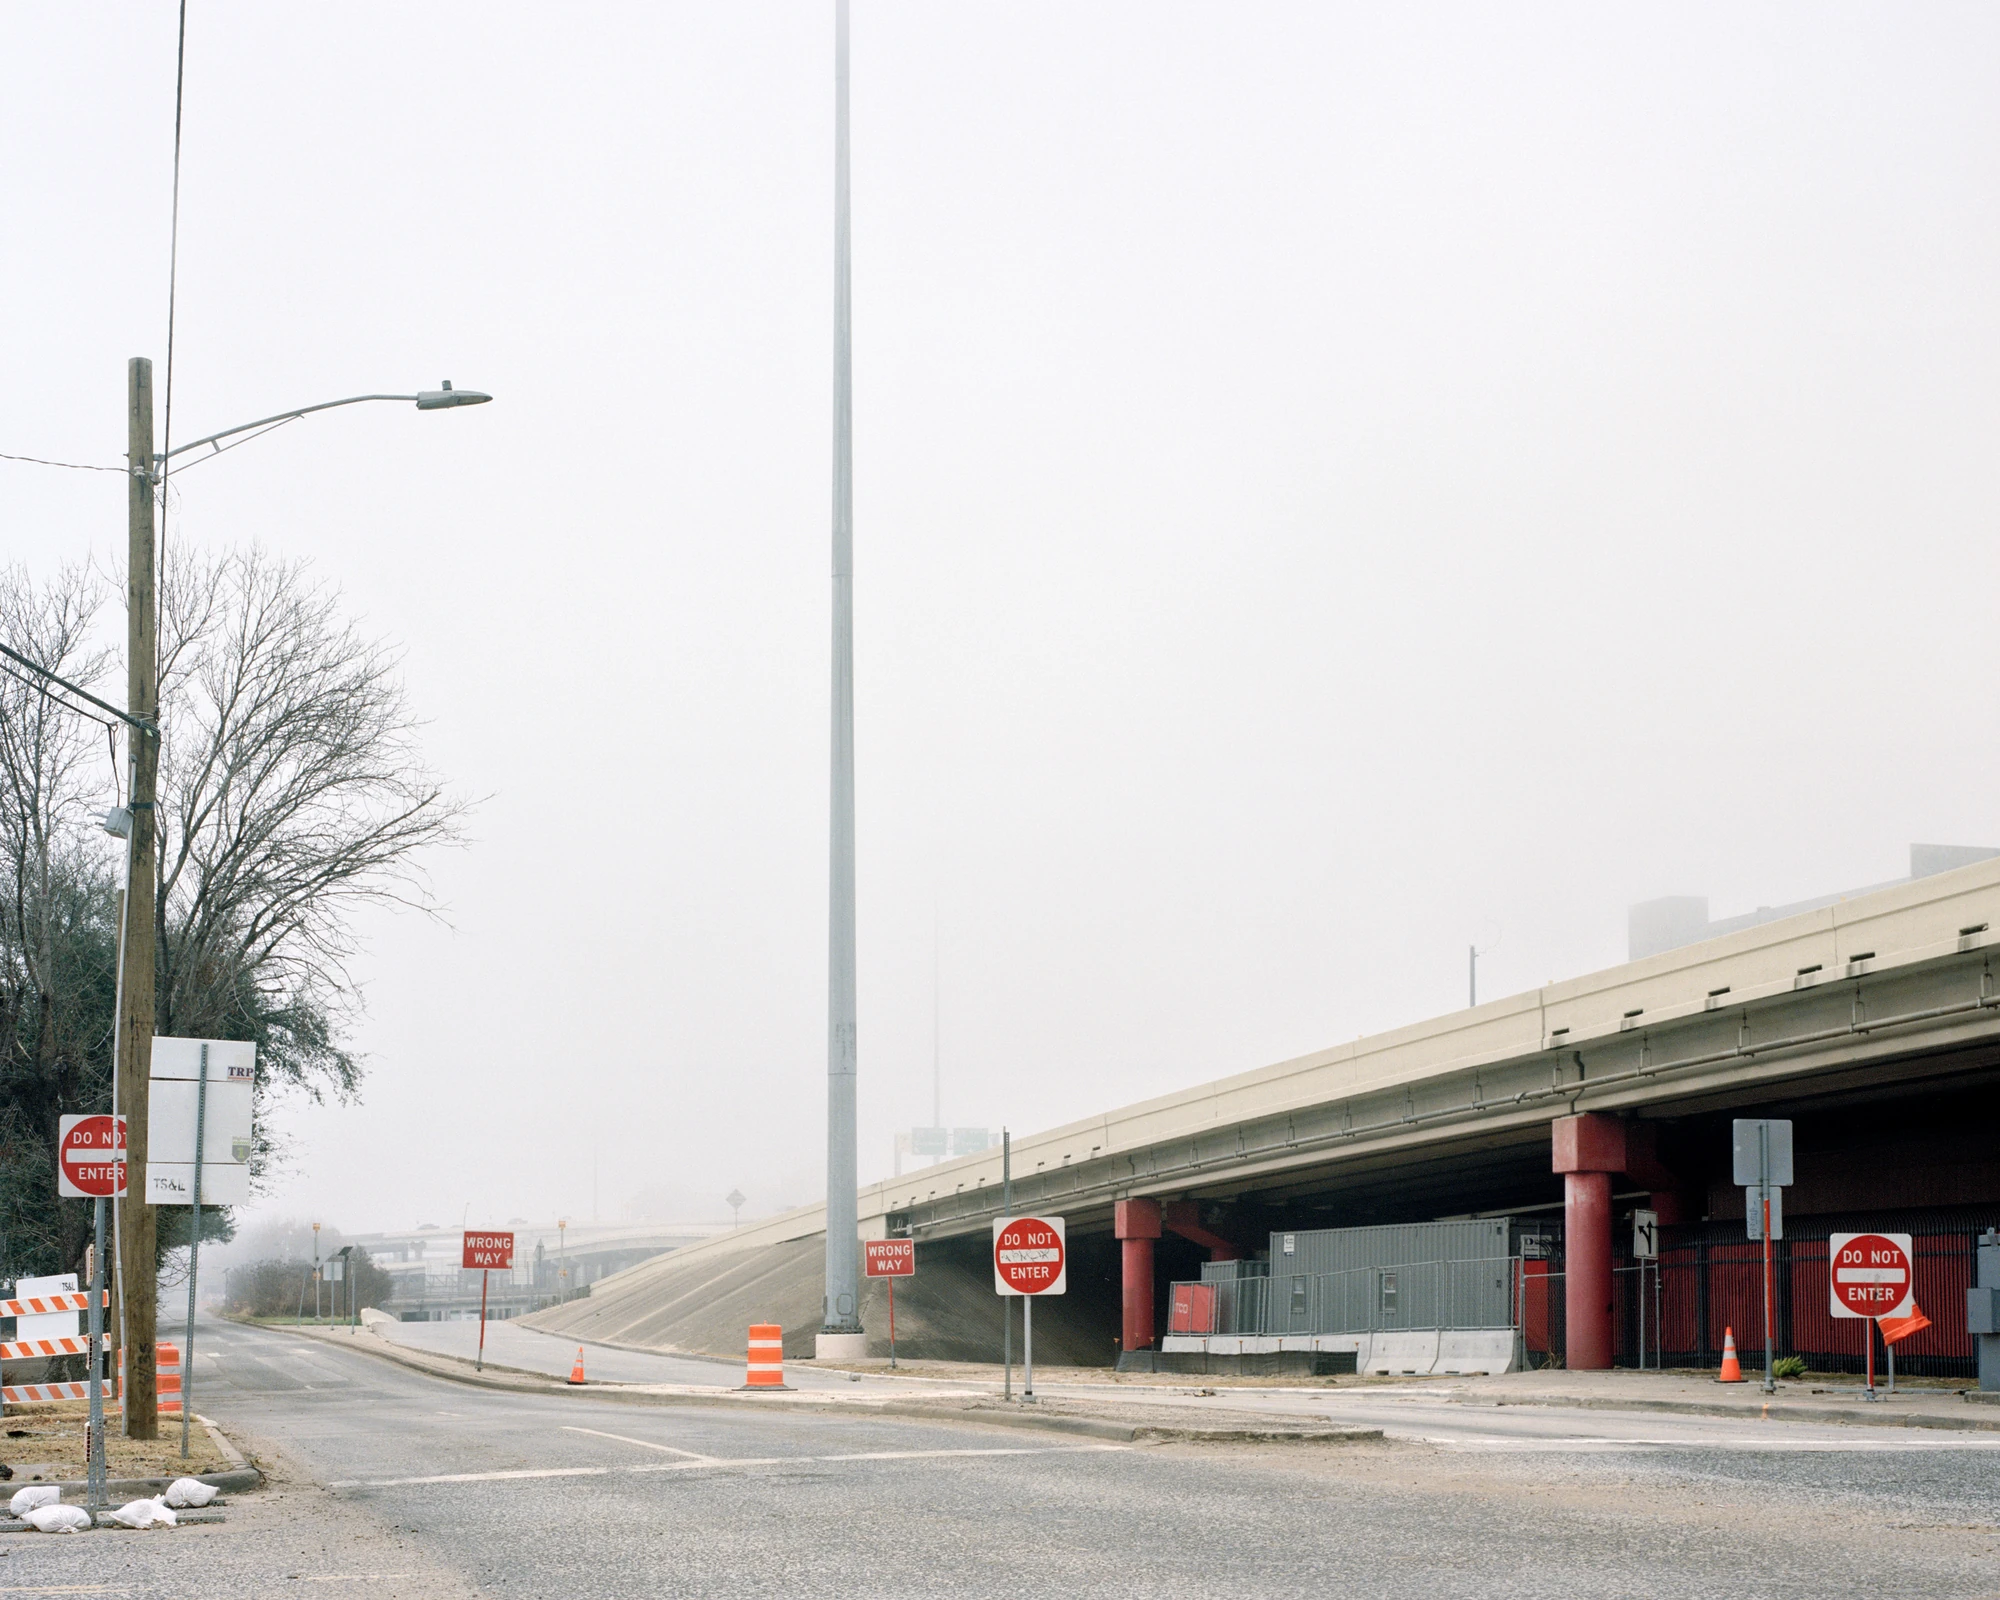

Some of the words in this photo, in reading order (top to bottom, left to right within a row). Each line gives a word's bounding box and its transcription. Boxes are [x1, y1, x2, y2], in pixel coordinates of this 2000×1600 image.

[228, 1066, 254, 1077] TRP
[73, 1132, 93, 1144] DO
[78, 1167, 124, 1180] ENTER
[466, 1237, 511, 1249] WRONG
[1004, 1233, 1020, 1246] DO
[1028, 1232, 1053, 1245] NOT
[868, 1244, 911, 1257] WRONG
[1843, 1250, 1863, 1264] DO
[1871, 1250, 1900, 1264] NOT
[474, 1252, 502, 1264] WAY
[877, 1259, 903, 1271] WAY
[1010, 1266, 1049, 1279] ENTER
[1848, 1287, 1895, 1301] ENTER
